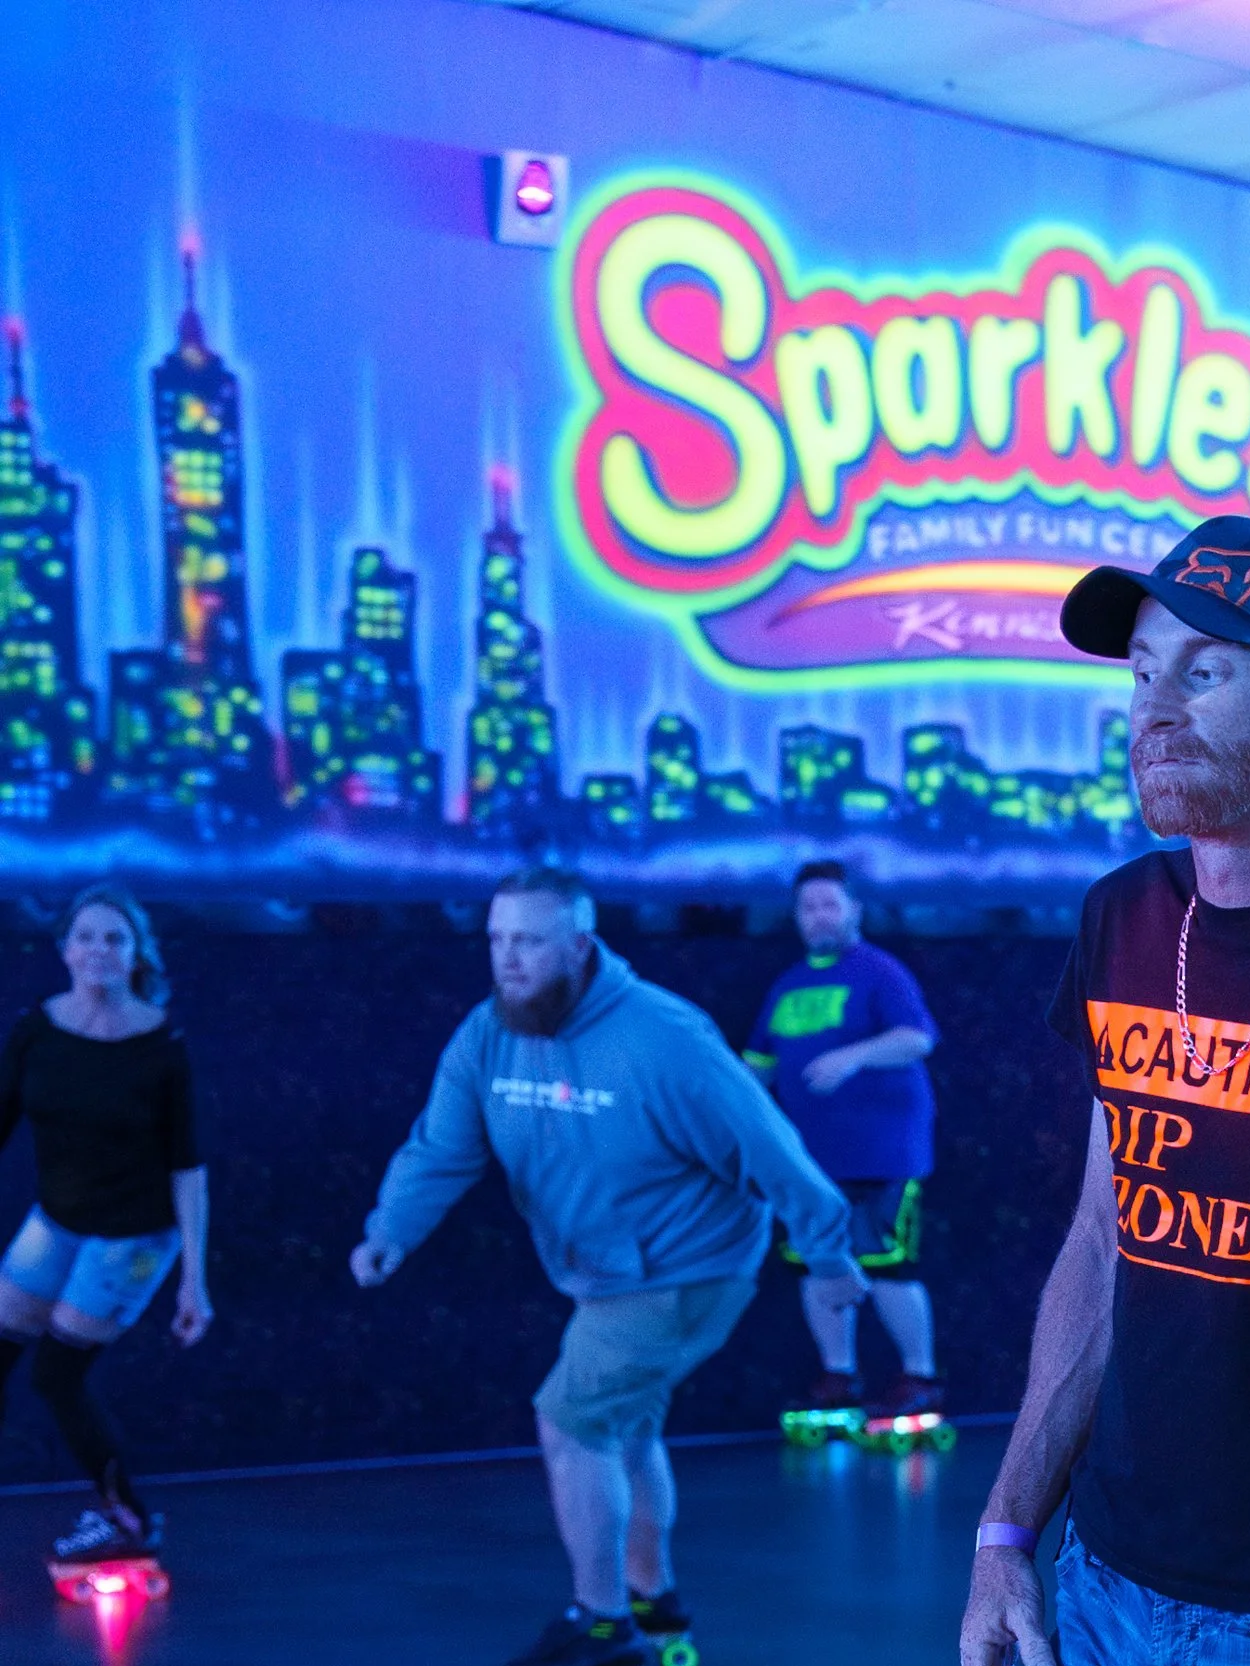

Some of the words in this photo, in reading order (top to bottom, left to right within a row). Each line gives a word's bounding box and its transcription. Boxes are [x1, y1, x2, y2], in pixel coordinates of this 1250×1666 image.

[868, 512, 1007, 560] FAMILY
[1016, 511, 1096, 547] FUN
[1101, 520, 1180, 559] CEN
